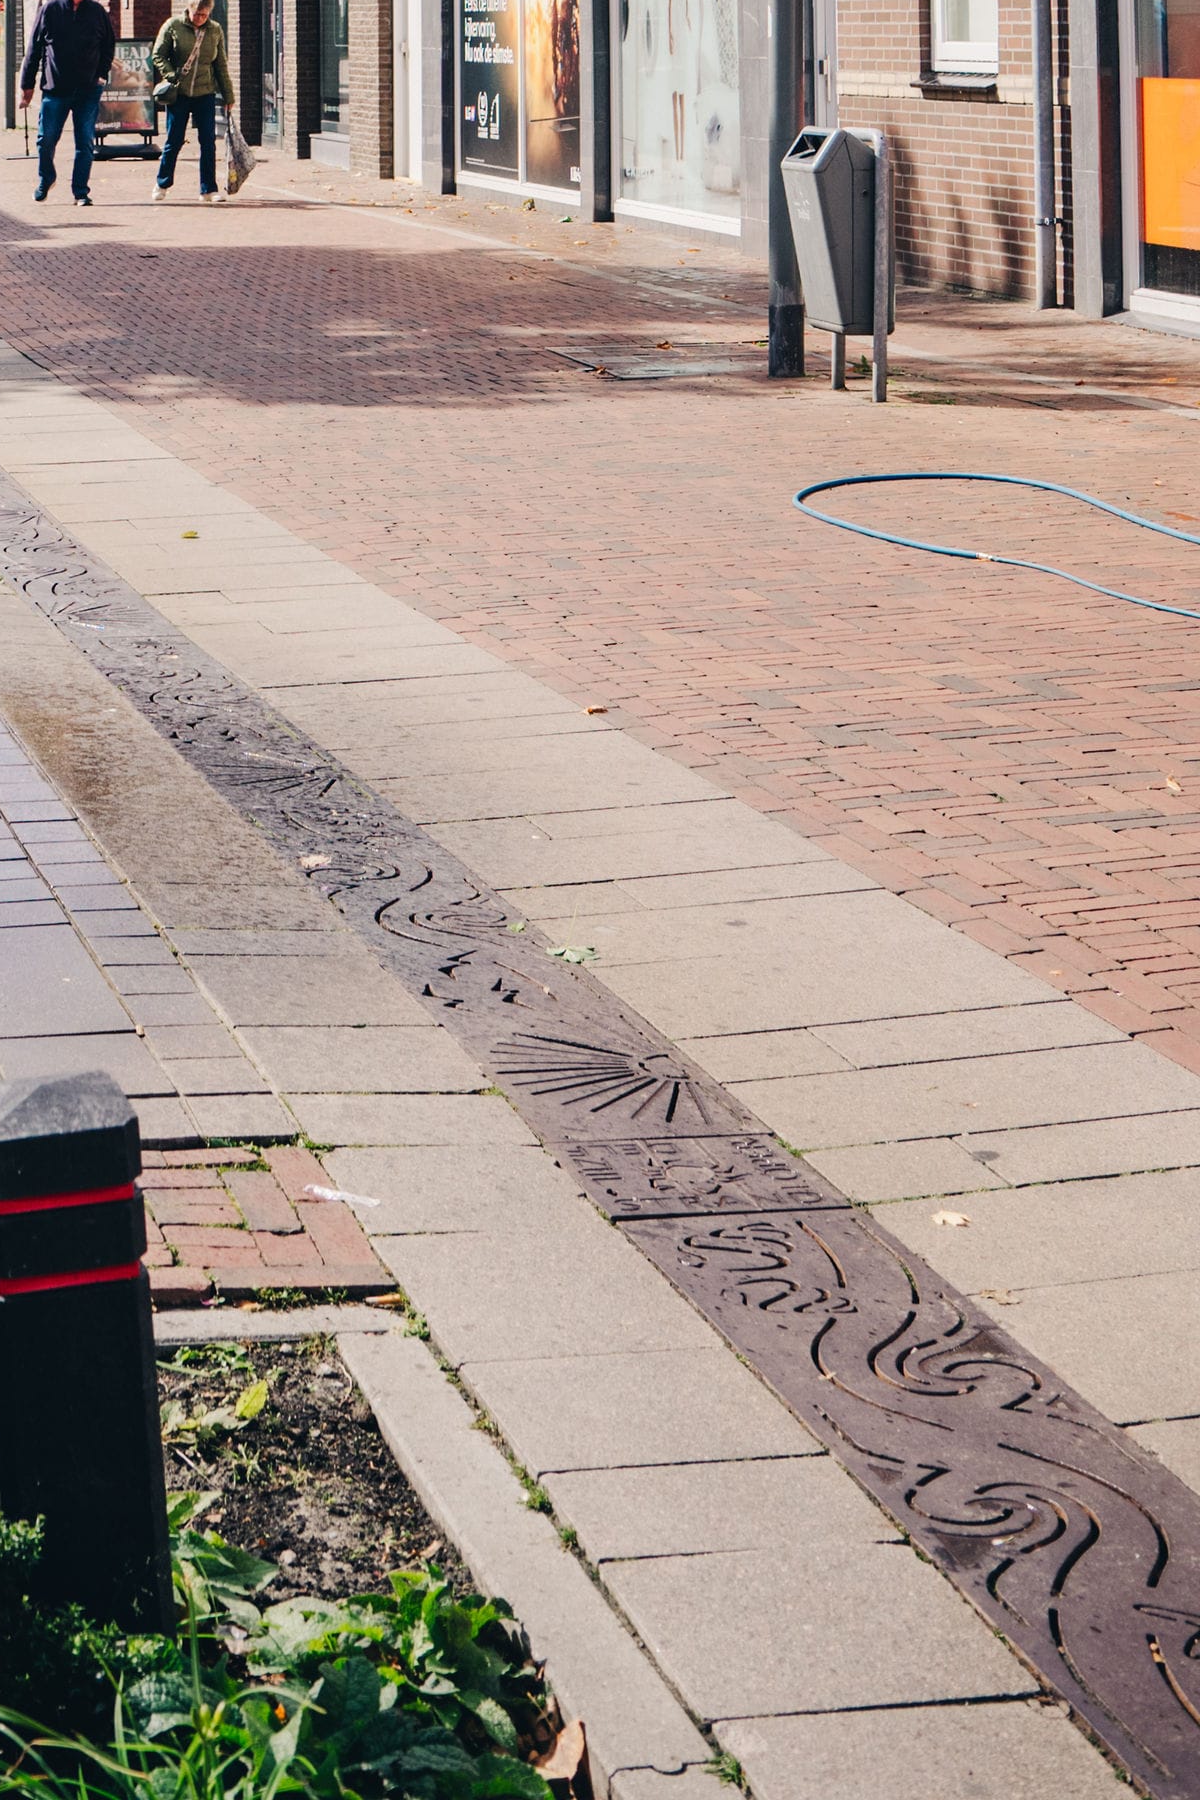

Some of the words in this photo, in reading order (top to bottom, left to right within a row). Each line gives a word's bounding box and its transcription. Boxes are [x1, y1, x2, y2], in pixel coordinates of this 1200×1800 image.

[464, 41, 473, 63] Nu
[473, 42, 484, 63] ook
[484, 42, 492, 64] de
[124, 59, 151, 73] SPA
